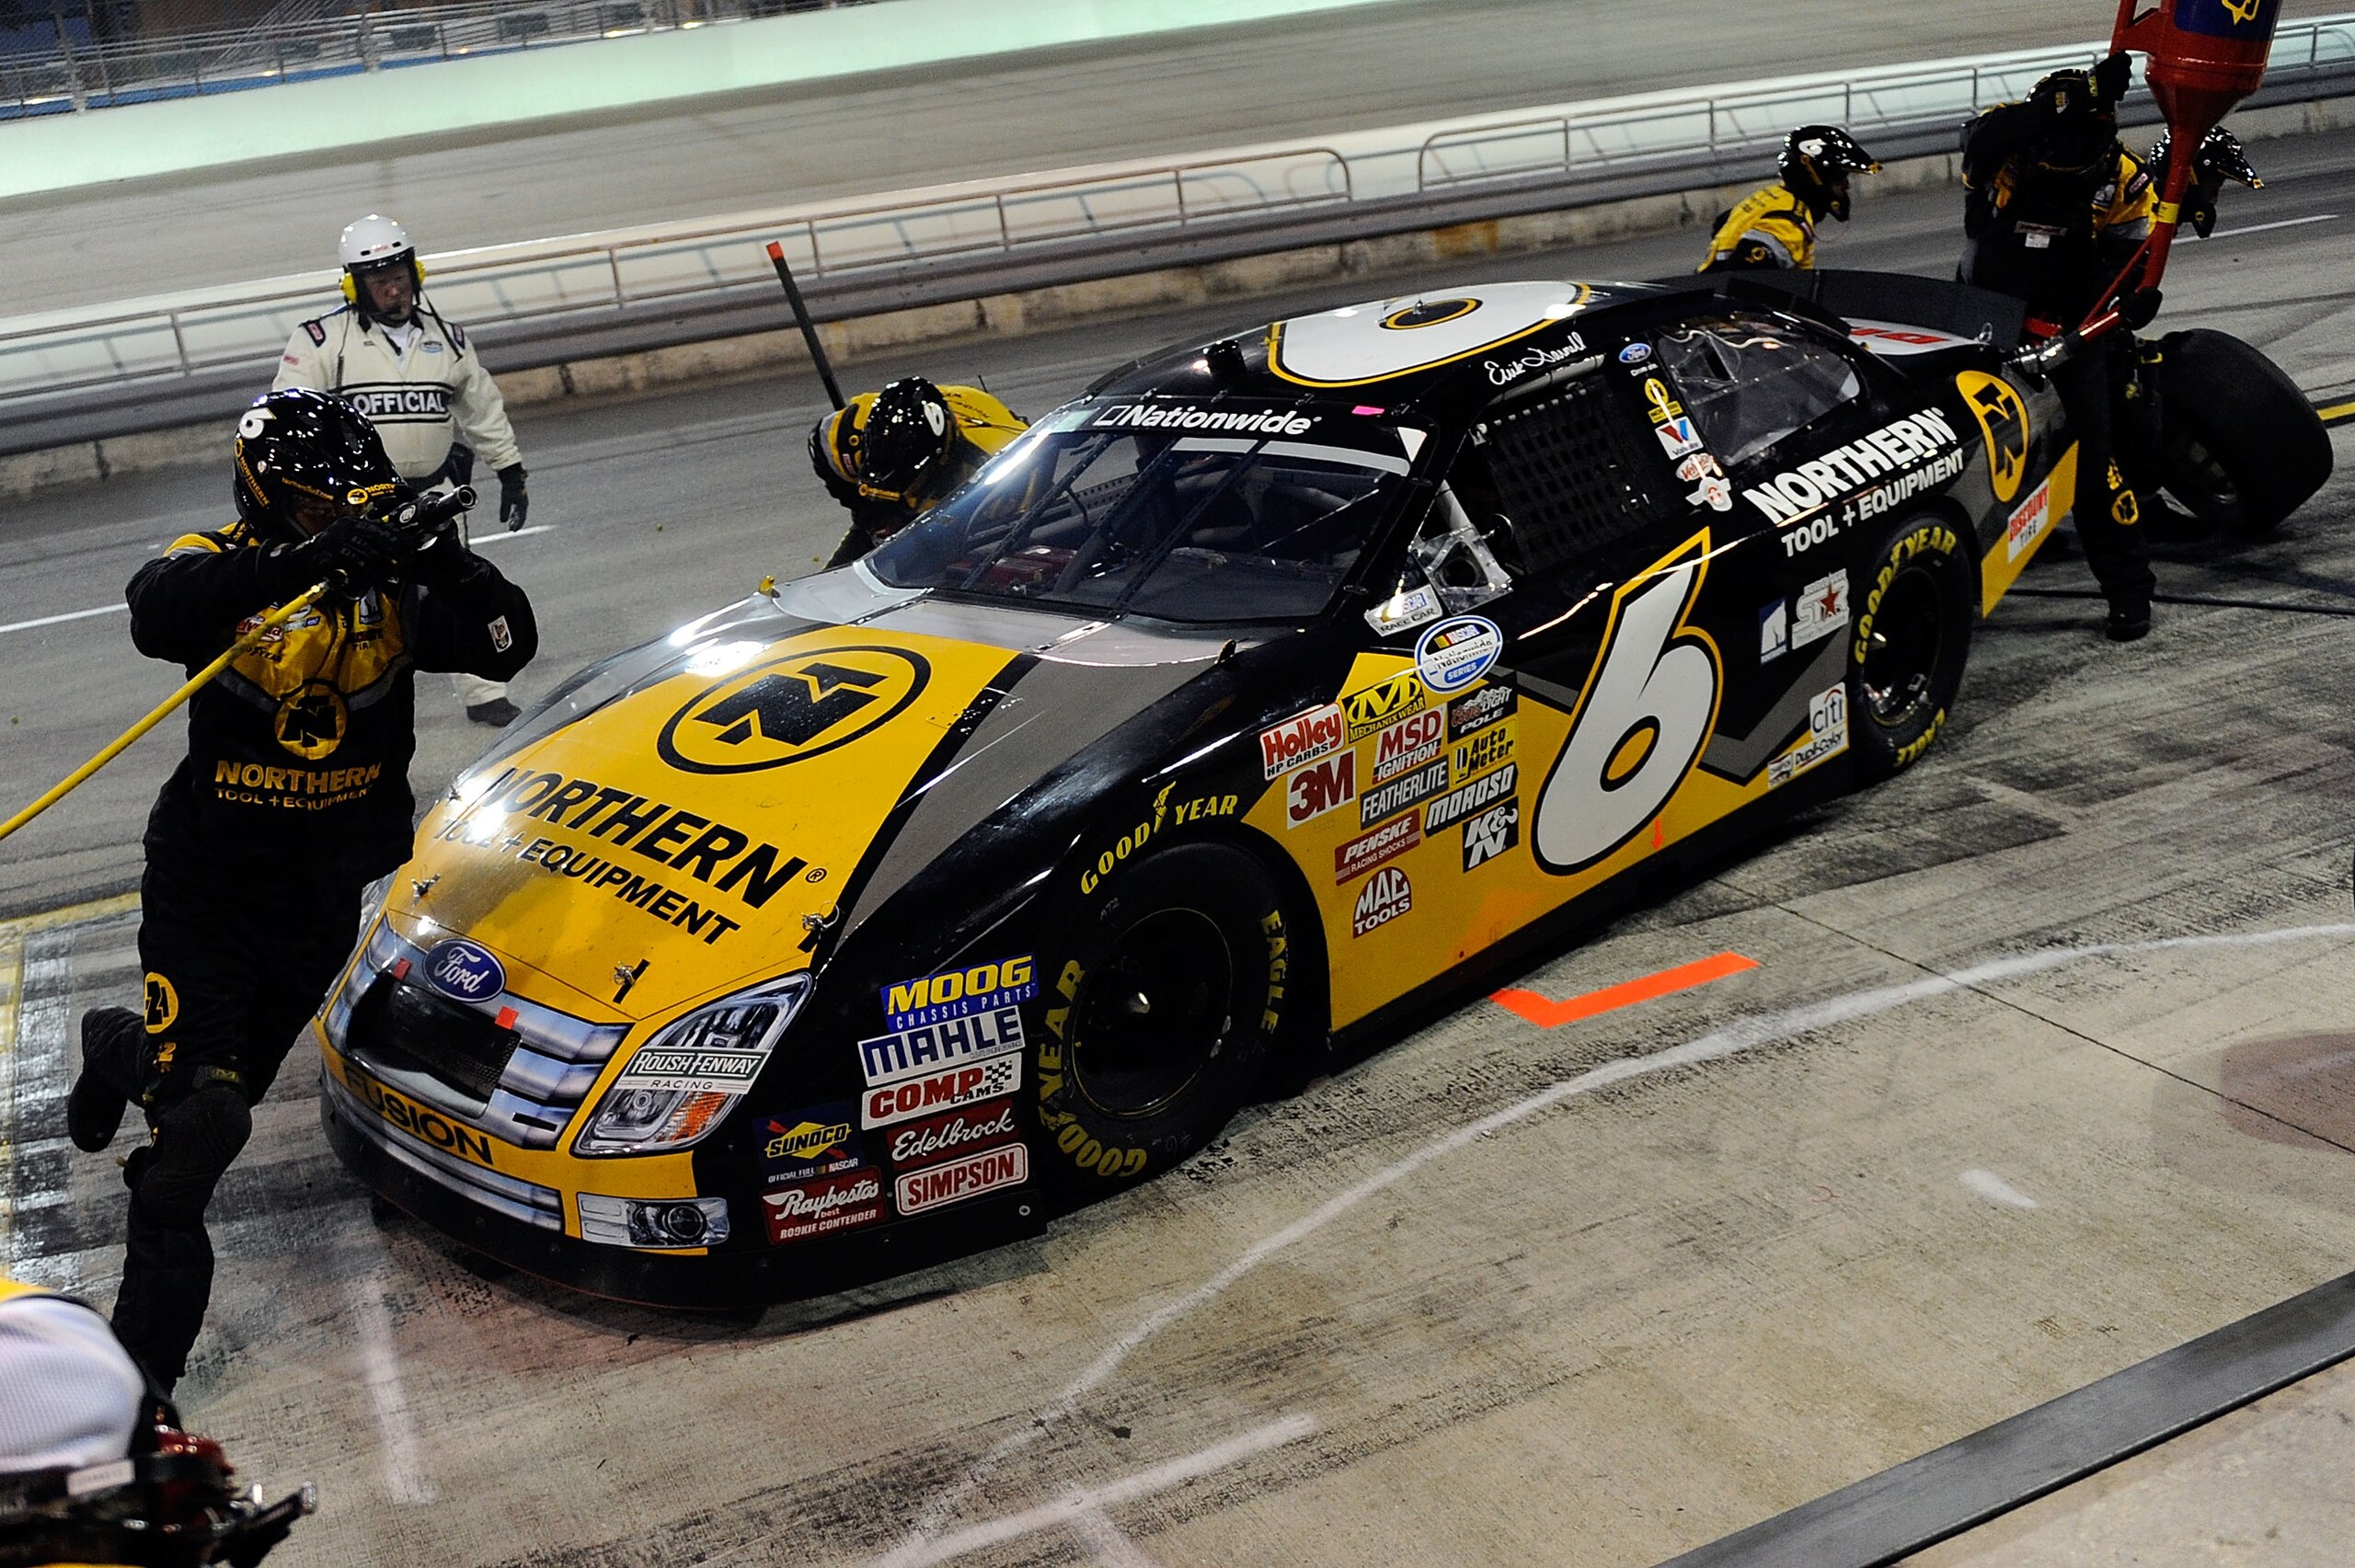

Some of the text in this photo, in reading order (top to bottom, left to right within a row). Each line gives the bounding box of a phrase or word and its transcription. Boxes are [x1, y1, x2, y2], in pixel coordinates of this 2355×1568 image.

[239, 407, 276, 440] 6
[352, 391, 446, 414] OFFICIAL
[1119, 405, 1312, 436] Nationwide
[1742, 407, 1958, 525] NORTHERN
[1781, 513, 1839, 557] TOOL
[1858, 448, 1965, 521] EQUIPMENT
[2007, 483, 2050, 541] DISCOUNT
[2017, 520, 2040, 547] TIRE
[1380, 607, 1437, 633] RACE CAR
[1447, 661, 1477, 681] SERIES
[1349, 696, 1425, 741] MECHANIX WEAR
[1460, 707, 1504, 734] POLE
[1534, 544, 1717, 869] 6
[1811, 696, 1844, 734] citi
[1263, 708, 1342, 767] Holley
[1380, 708, 1442, 758] MSD
[1470, 727, 1507, 756] Auto
[1267, 742, 1329, 777] HP CARBS
[1376, 740, 1441, 782] IGNITION
[1469, 739, 1515, 772] Meter
[214, 760, 383, 795] NORTHERN
[214, 787, 264, 806] TOOL
[1288, 750, 1354, 823] 3M
[1361, 760, 1448, 824] FEATHERLITE
[1426, 763, 1514, 830] MOROSO
[478, 766, 810, 910] NORTHERN
[1344, 817, 1412, 864] PENSKE
[1350, 838, 1407, 874] RACING SHOCKS
[1469, 830, 1506, 868] N
[518, 838, 741, 945] EQUIPMENT
[1355, 870, 1410, 920] MAC
[1354, 898, 1411, 935] TOOLS
[433, 945, 492, 993] Ford
[887, 954, 1032, 1015] MOOG
[1260, 909, 1288, 1034] EAGLE
[895, 987, 1033, 1030] CHASSIS PARTS
[862, 1006, 1022, 1078] MAHLE
[635, 1051, 760, 1078] ROUSH FENWAY
[649, 1079, 715, 1091] RACING
[869, 1066, 984, 1119] COMP
[949, 1082, 1005, 1106] CAMS
[343, 1066, 494, 1166] FUSION
[891, 1107, 1016, 1162] Edelbrock
[769, 1124, 849, 1157] SUNOCO
[767, 1171, 798, 1185] OFFICIAL
[828, 1157, 859, 1173] NASCAR
[907, 1150, 1016, 1206] SIMPSON
[763, 1178, 879, 1221] Raybestos
[821, 1207, 841, 1219] best
[780, 1208, 878, 1240] ROOKIE CONTENDER
